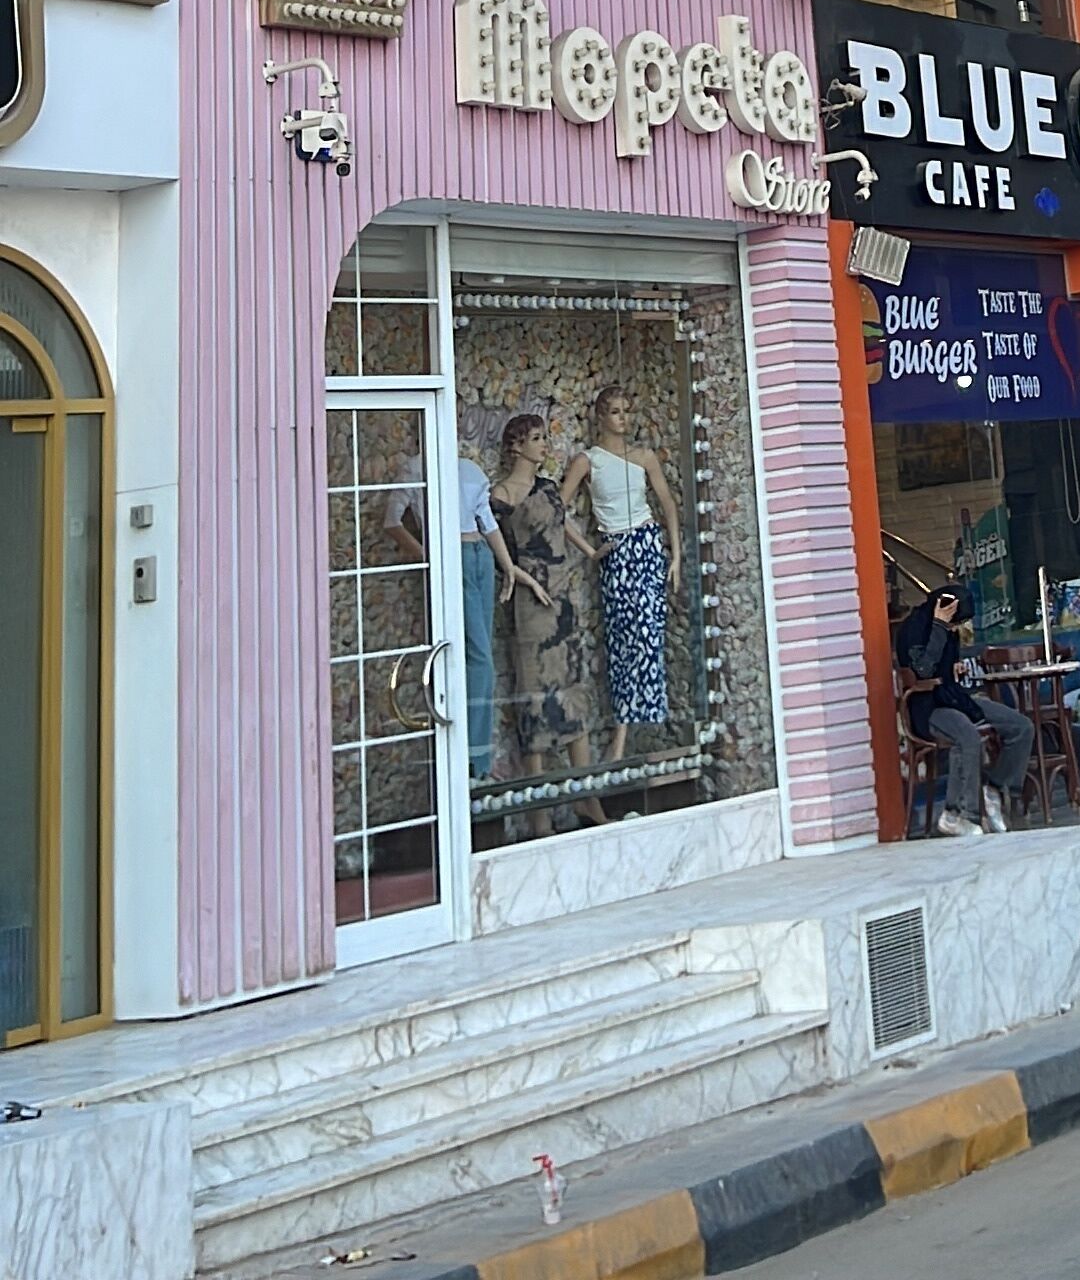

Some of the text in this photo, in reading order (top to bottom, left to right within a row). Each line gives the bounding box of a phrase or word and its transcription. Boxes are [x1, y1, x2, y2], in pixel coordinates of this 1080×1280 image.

[847, 39, 1067, 160] BLUE
[726, 148, 831, 216] Store
[924, 159, 1016, 211] CAFE
[885, 294, 941, 335] BLUE
[977, 288, 1043, 318] TASTE THE
[889, 339, 978, 383] BURGER
[982, 331, 1038, 360] TASTE OF
[987, 374, 1041, 403] OUR FOOD
